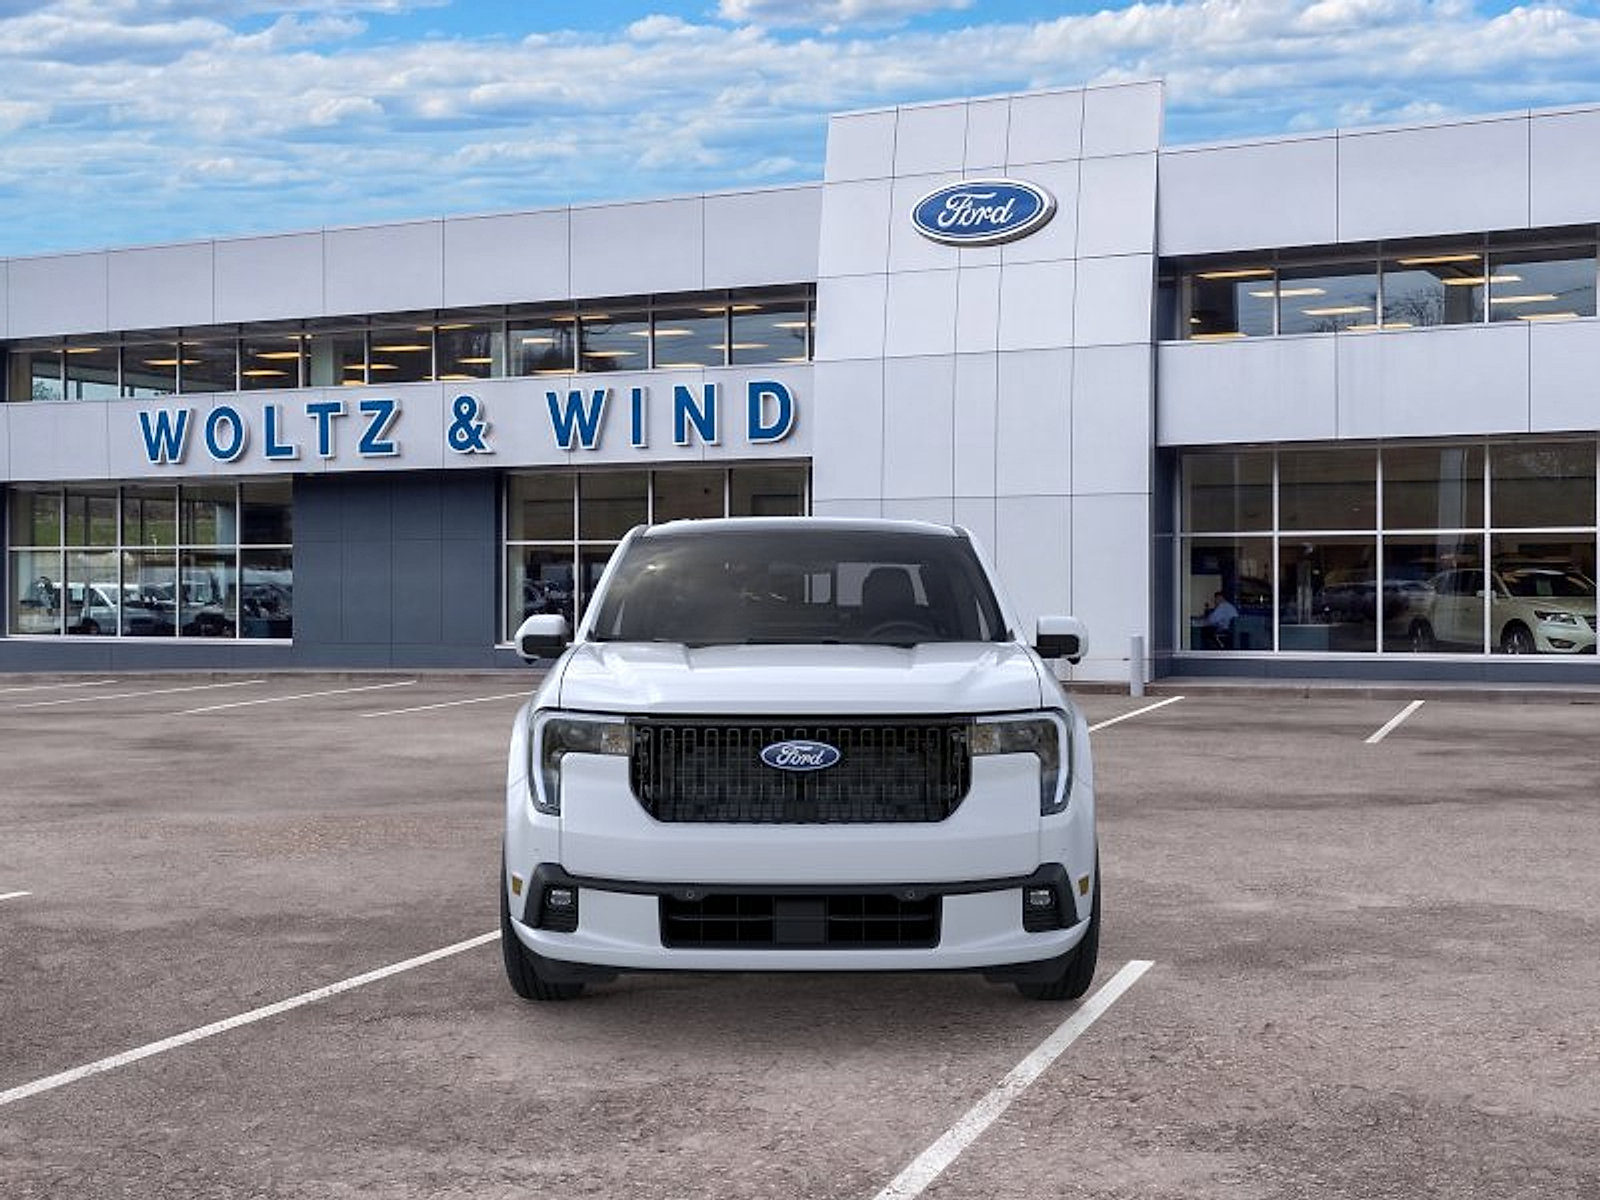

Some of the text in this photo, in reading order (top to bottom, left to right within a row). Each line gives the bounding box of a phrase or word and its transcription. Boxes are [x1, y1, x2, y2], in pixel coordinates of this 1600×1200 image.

[938, 192, 1015, 228] Ford
[139, 380, 796, 464] WOLTZ & WIND
[776, 746, 825, 765] Ford
